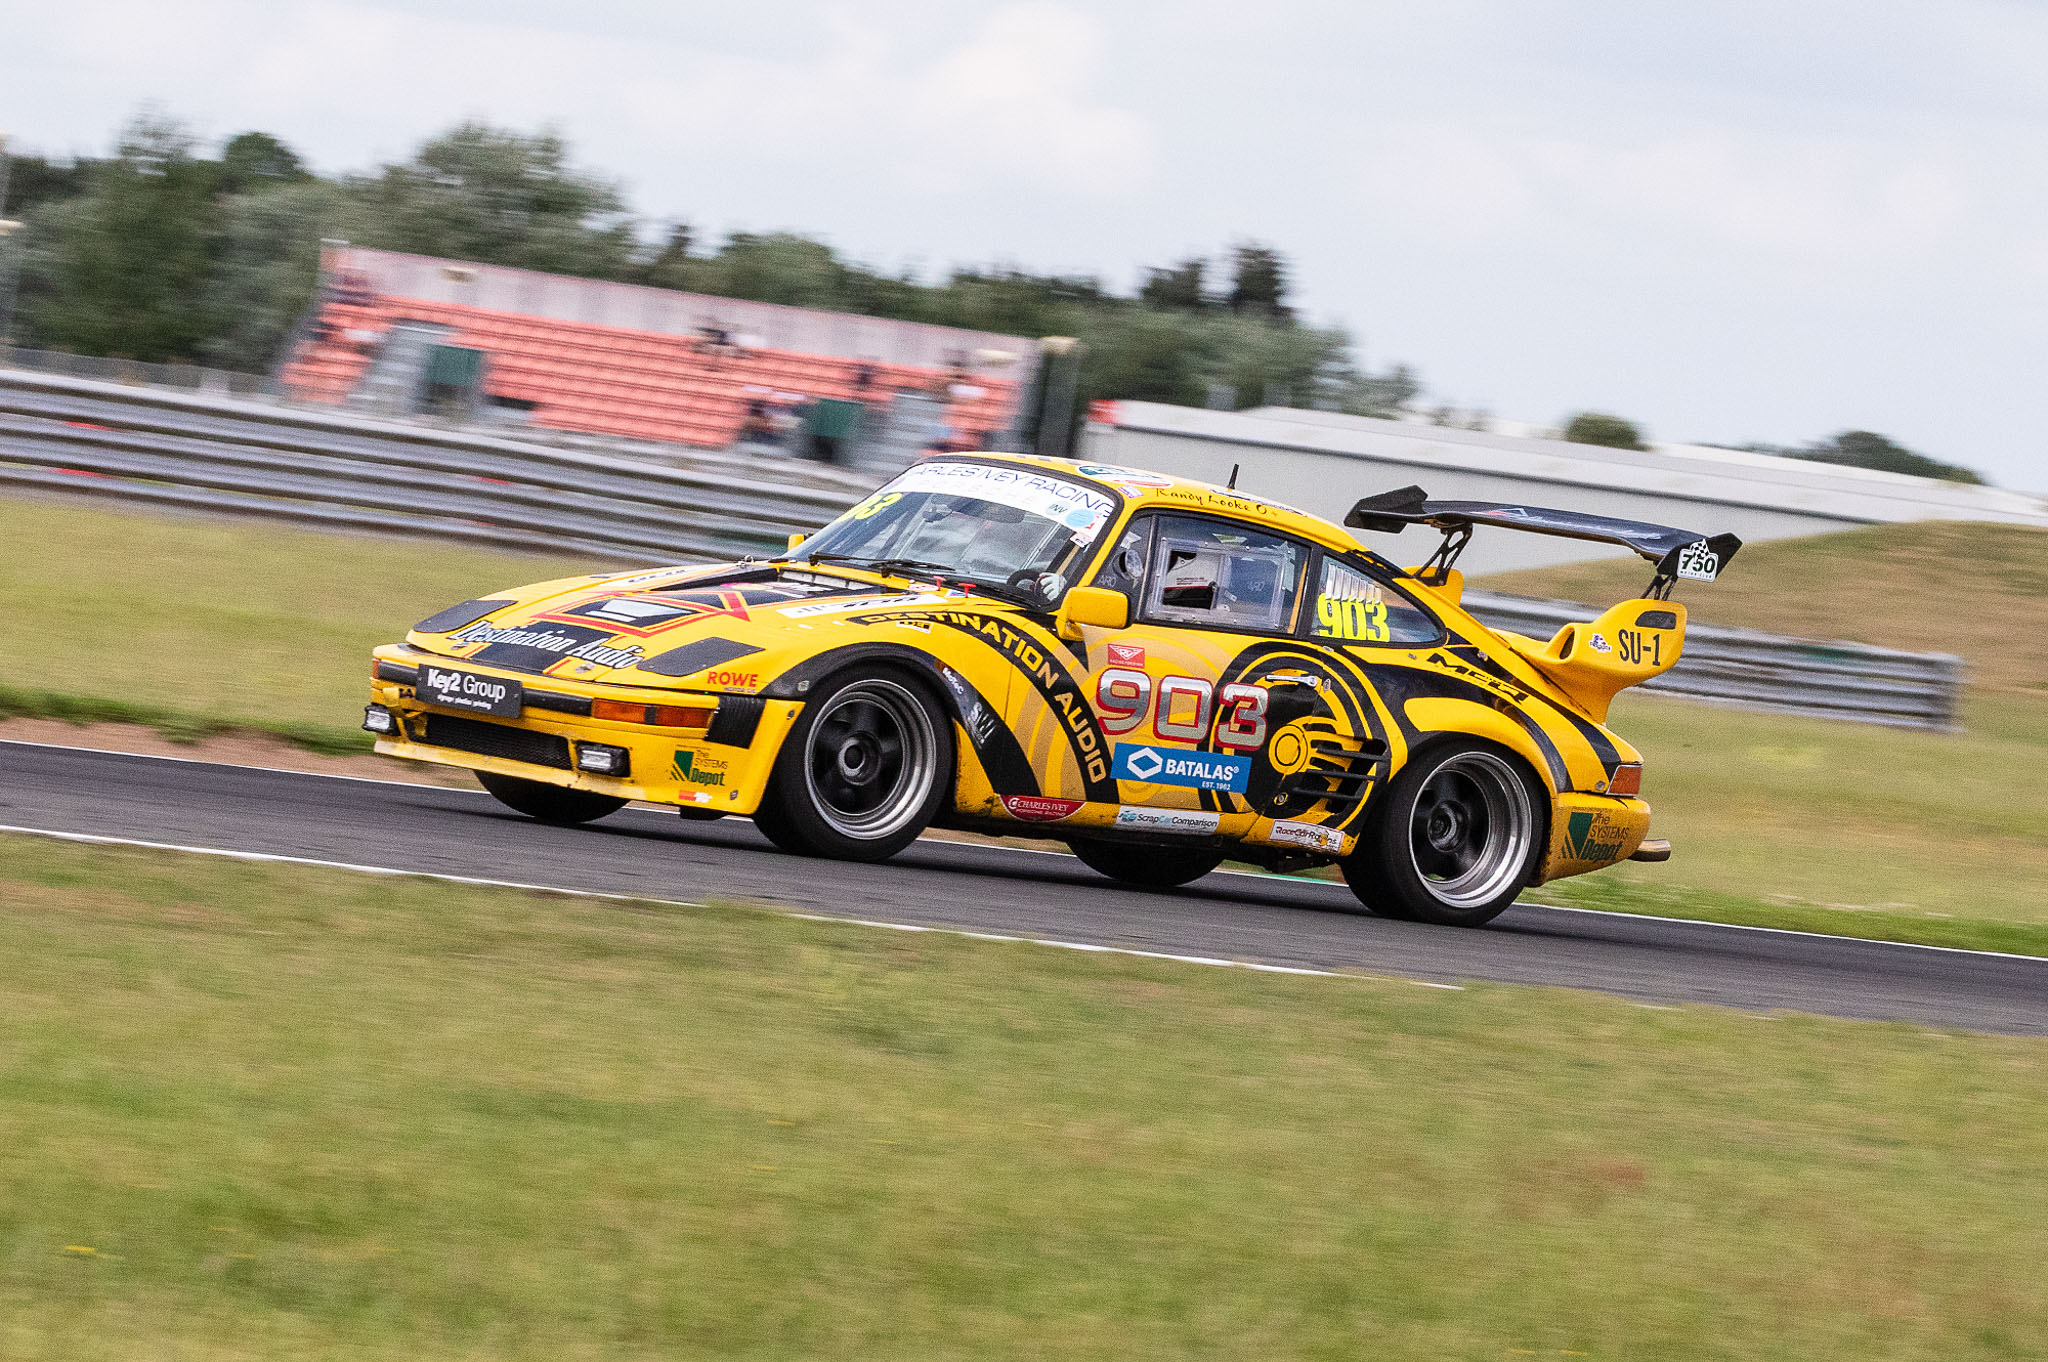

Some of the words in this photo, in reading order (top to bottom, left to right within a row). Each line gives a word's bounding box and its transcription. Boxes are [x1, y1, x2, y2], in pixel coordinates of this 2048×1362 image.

[977, 469, 1030, 486] IVEY
[1681, 553, 1716, 574] 750
[1318, 592, 1390, 642] 903
[448, 620, 577, 652] Destination
[565, 638, 645, 670] Audio
[1618, 628, 1661, 667] SU-1
[427, 668, 461, 694] Key2
[463, 675, 506, 703] Group
[707, 671, 758, 687] ROWE
[861, 612, 1060, 689] DESTINATION
[1054, 691, 1107, 784] AUDIO
[1096, 667, 1270, 751] 903
[691, 767, 725, 787] Depot
[1592, 811, 1611, 825] The
[1590, 824, 1630, 840] SYSTEMS
[1580, 838, 1623, 864] Depot
